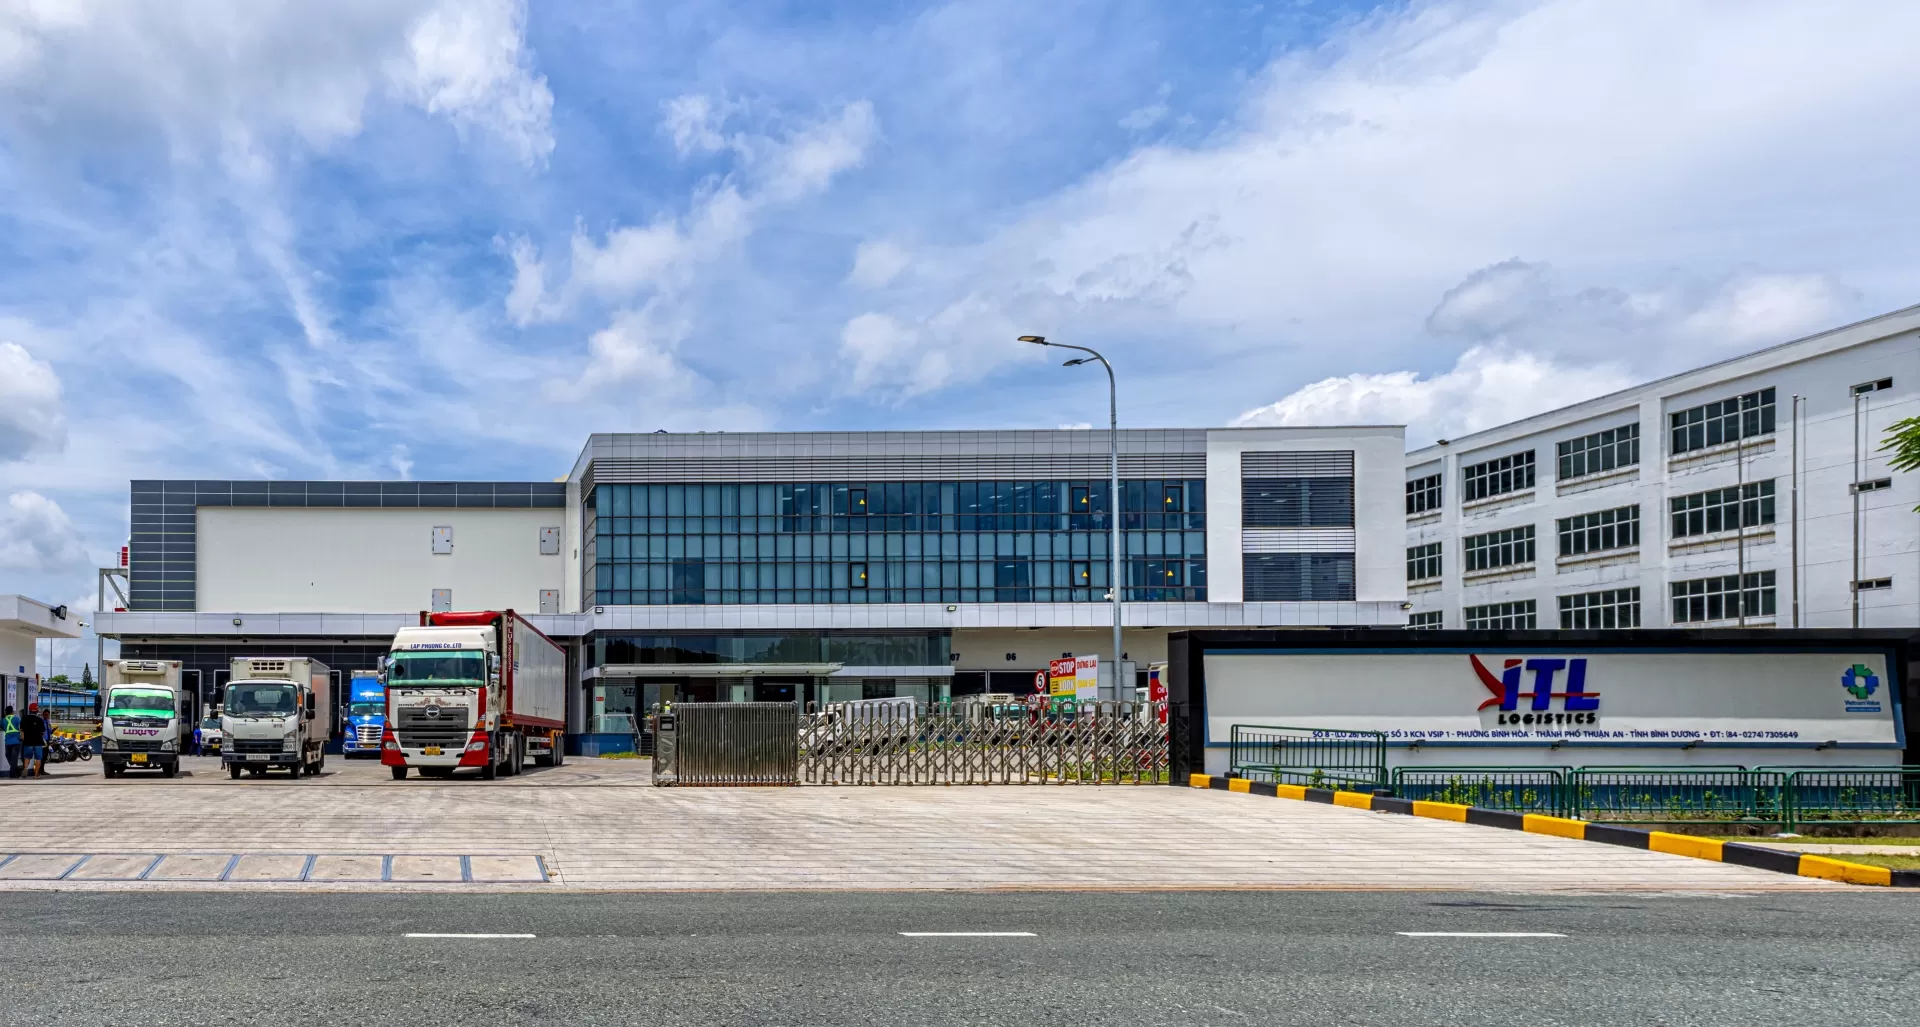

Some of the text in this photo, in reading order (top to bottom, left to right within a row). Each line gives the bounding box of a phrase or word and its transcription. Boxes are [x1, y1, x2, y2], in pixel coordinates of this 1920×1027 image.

[950, 653, 961, 661] 07
[1006, 653, 1016, 661] 06
[1058, 661, 1075, 674] STOP
[1037, 674, 1043, 688] 5
[1059, 680, 1075, 692] LOOK
[1498, 712, 1597, 725] LOGISTICS
[123, 729, 159, 737] LUXURY
[1391, 729, 1401, 738] SỐ
[1404, 730, 1408, 738] 3
[1456, 729, 1489, 738] PHƯỜNG
[1491, 729, 1510, 738] BÌNH
[1511, 729, 1529, 738] HÒA
[1536, 729, 1562, 738] THÀNH
[1565, 728, 1580, 738] PHỐ
[1650, 729, 1669, 738] BÌNH
[1765, 730, 1799, 738] 7305649
